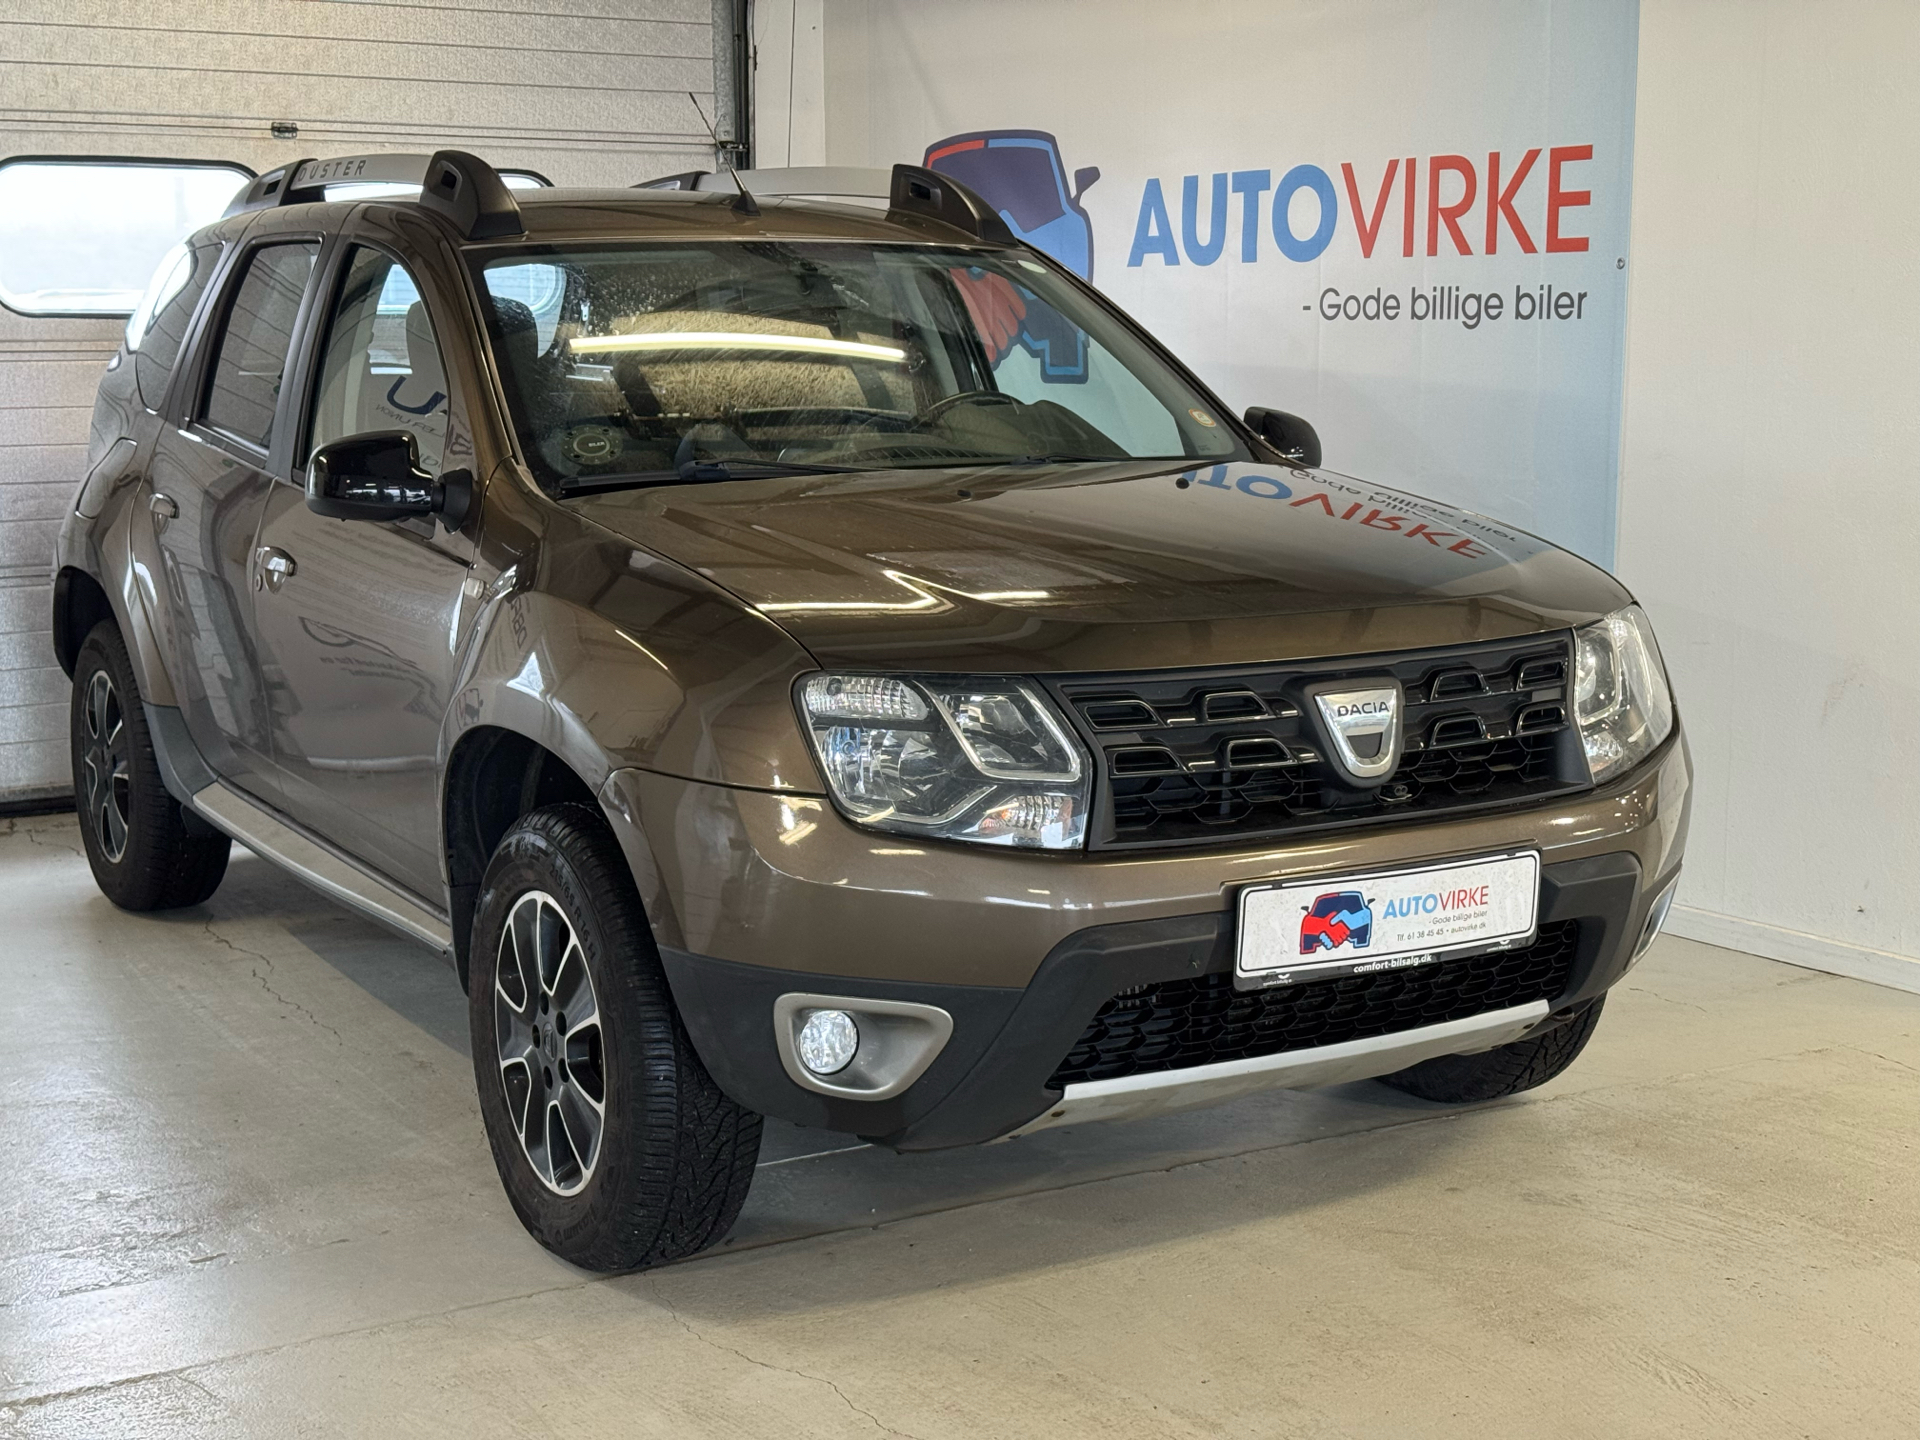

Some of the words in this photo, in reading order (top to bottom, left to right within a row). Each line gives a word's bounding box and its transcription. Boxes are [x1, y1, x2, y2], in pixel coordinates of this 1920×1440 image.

[297, 159, 367, 182] DUSTER
[1127, 144, 1593, 267] AUTOVIRKE
[1319, 287, 1401, 321] Gode
[1410, 285, 1504, 330] billige
[1514, 284, 1588, 321] biler
[1337, 701, 1390, 717] DACIA
[1382, 885, 1489, 920] AUTOVIRKE
[1432, 916, 1452, 925] Gode
[1353, 954, 1432, 973] comfort-bilsalg.dk
